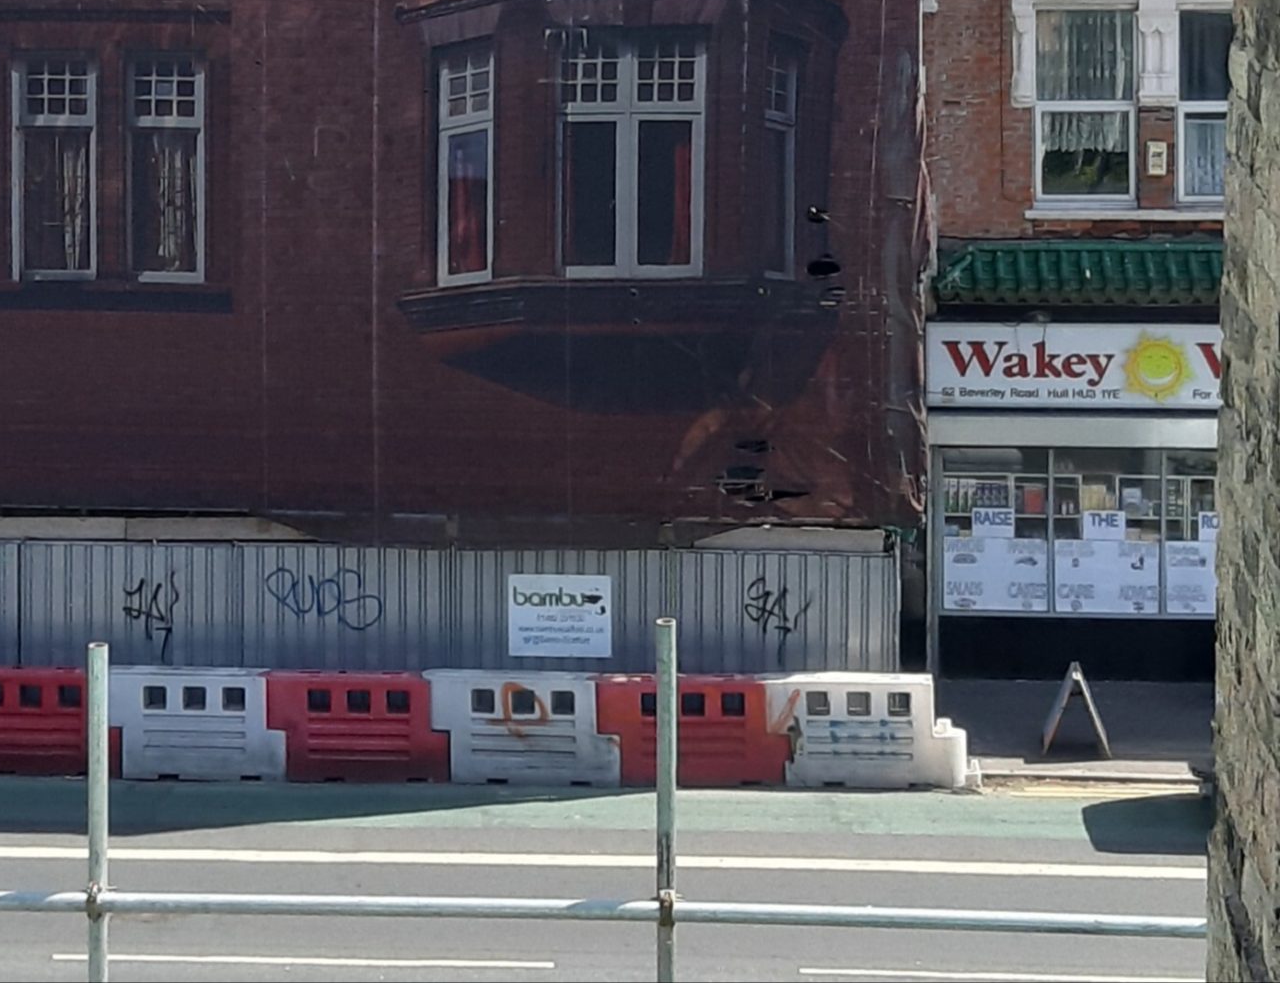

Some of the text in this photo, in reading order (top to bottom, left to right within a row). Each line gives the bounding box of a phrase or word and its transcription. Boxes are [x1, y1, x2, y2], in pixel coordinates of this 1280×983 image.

[941, 340, 1115, 387] Wakey
[959, 387, 1005, 399] Beverley
[1010, 388, 1039, 398] Road
[1047, 388, 1069, 398] Hull
[1193, 389, 1212, 399] For
[974, 510, 1013, 526] RAISE
[1088, 513, 1120, 528] THE
[513, 586, 586, 607] bambu
